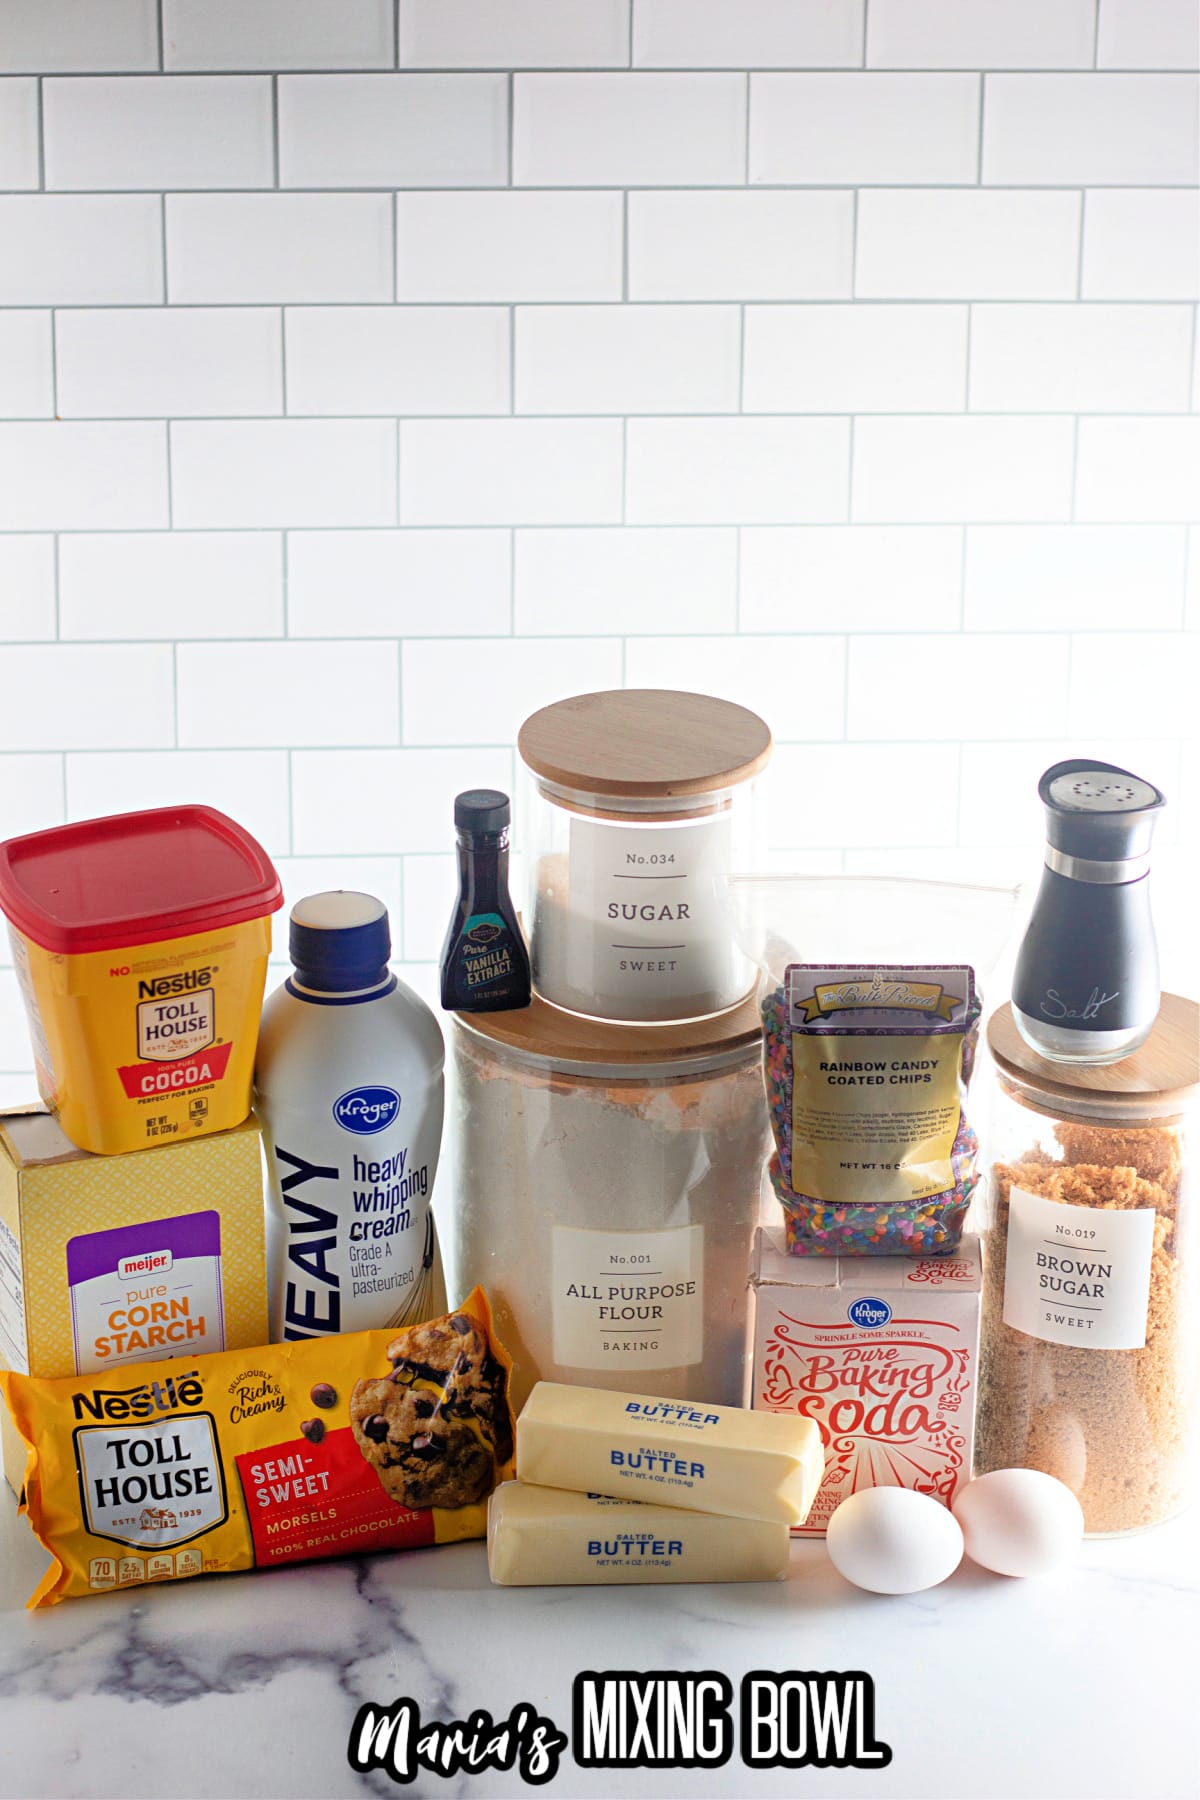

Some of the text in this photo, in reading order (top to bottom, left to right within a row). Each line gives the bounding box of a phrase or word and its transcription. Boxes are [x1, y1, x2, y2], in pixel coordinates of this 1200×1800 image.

[626, 853, 675, 864] No.034
[607, 902, 690, 921] SUGAR
[462, 944, 488, 955] Pure
[465, 949, 509, 972] VANILLA
[110, 966, 130, 977] NO
[466, 960, 511, 985] EXTRACT
[619, 960, 677, 971] SWEET
[155, 1001, 199, 1021] TOLL
[1040, 986, 1119, 1020] Salt
[146, 1016, 208, 1041] HOUSE
[819, 1060, 939, 1072] RAINBOW CANDY
[140, 1063, 212, 1093] COCOA
[827, 1073, 932, 1085] COATED CHIPS
[138, 1094, 170, 1104] PERFECT
[187, 1083, 215, 1095] BAKING
[339, 1097, 396, 1124] Kroger
[353, 1148, 408, 1184] heavy
[353, 1164, 428, 1214] whipping
[349, 1207, 411, 1241] cream
[1055, 1224, 1097, 1239] No.019
[349, 1241, 393, 1262] Grade A
[609, 1255, 652, 1264] No.001
[124, 1255, 167, 1275] meijer
[351, 1262, 382, 1278] ultra-
[907, 1269, 974, 1282] Soda
[916, 1261, 968, 1270] Baking
[1036, 1252, 1112, 1279] BROWN
[352, 1266, 414, 1298] pasteurized
[566, 1281, 696, 1300] ALL PURPOSE
[1039, 1274, 1106, 1298] SUGAR
[126, 1284, 167, 1306] pure
[108, 1296, 189, 1331] CORN
[599, 1306, 664, 1320] FLOUR
[855, 1302, 887, 1324] Kroger
[1045, 1312, 1094, 1329] SWEET
[94, 1315, 206, 1358] STARCH
[603, 1341, 659, 1351] BAKING
[814, 1332, 857, 1342] SPRINKLE
[858, 1331, 885, 1339] SOME
[842, 1348, 899, 1366] Pure
[228, 1369, 273, 1394] DELICIOUSLY
[799, 1355, 935, 1398] Baking
[236, 1380, 281, 1406] Rich &
[230, 1395, 288, 1424] Creamy
[625, 1402, 720, 1425] BUTTER
[658, 1402, 694, 1412] SALTED
[798, 1390, 946, 1448] Soda
[106, 1434, 191, 1470] TOLL
[639, 1447, 676, 1459] SALTED
[250, 1454, 313, 1484] SEMI-
[610, 1450, 704, 1479] BUTTER
[94, 1467, 213, 1508] HOUSE
[256, 1471, 329, 1507] SWEET
[179, 1508, 202, 1518] 1939
[266, 1508, 337, 1535] MORSELS
[270, 1511, 420, 1556] 100% REAL CHOCOLATE
[587, 1540, 683, 1556] BUTTER
[95, 1561, 110, 1576] 70
